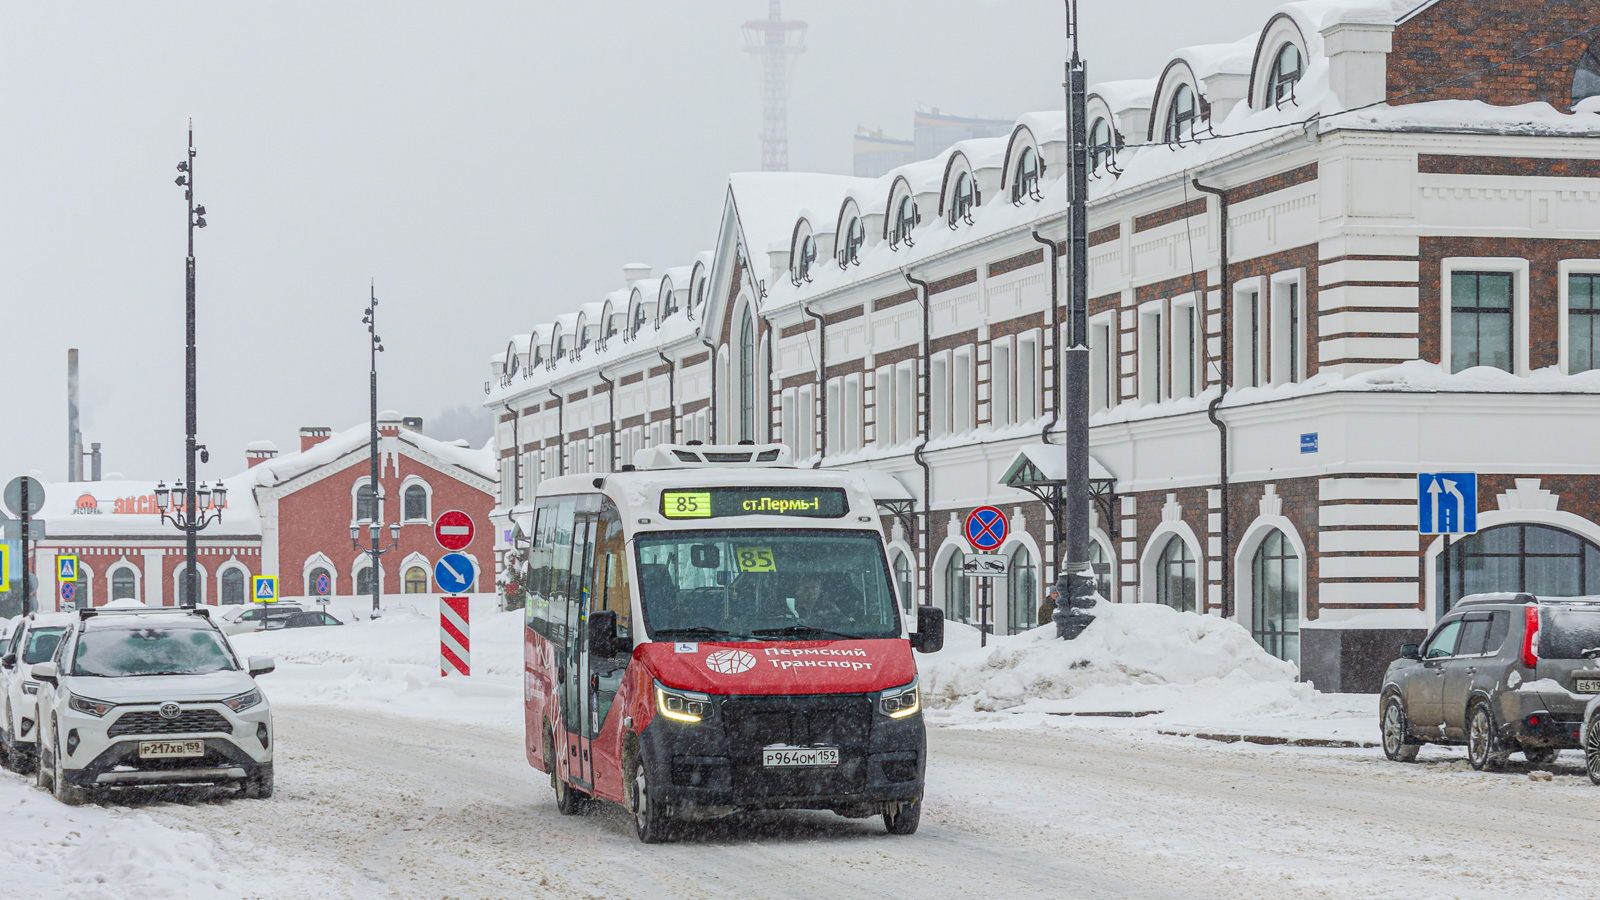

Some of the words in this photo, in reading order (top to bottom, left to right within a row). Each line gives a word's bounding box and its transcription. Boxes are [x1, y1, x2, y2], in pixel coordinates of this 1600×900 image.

[676, 496, 698, 512] 85
[741, 551, 772, 568] 85
[764, 647, 867, 657] Пермский
[768, 659, 873, 671] Транспорт
[144, 744, 184, 754] Р217ХВ
[185, 742, 201, 751] 159
[767, 751, 816, 765] Р964ОМ
[818, 750, 836, 761] 159
